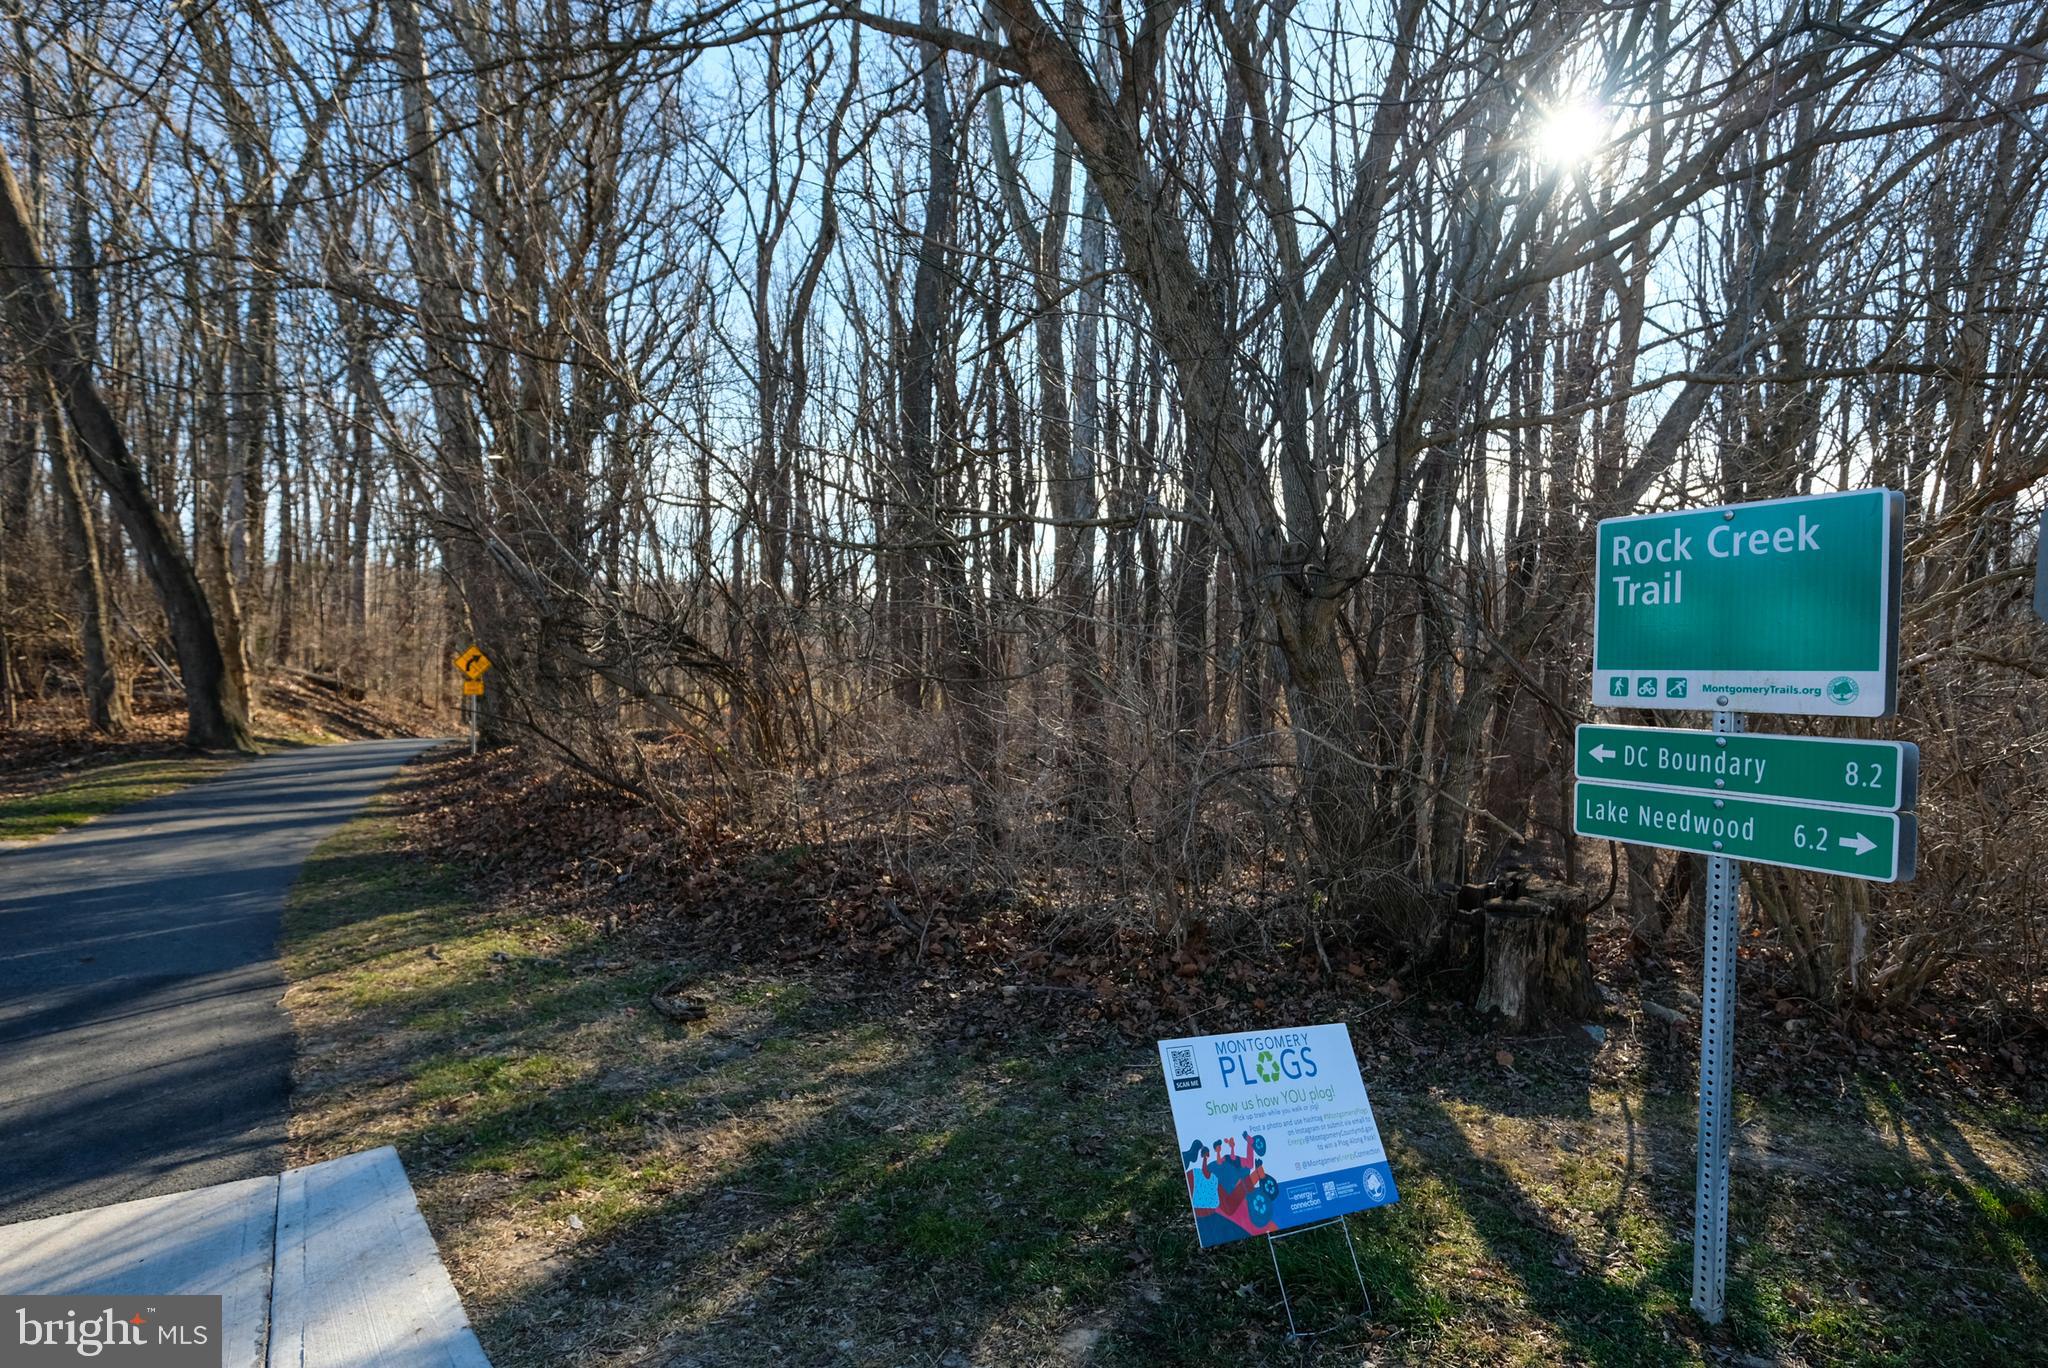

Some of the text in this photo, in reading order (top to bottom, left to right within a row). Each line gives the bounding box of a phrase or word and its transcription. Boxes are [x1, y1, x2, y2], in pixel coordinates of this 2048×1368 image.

[1612, 514, 1821, 566] Rock Creek
[1612, 570, 1683, 606] Trail
[1702, 684, 1822, 698] MontgomeryTrails.org
[1624, 745, 1883, 789] DC Boundary 8.2
[1586, 799, 1828, 851] Lake Needwood 6.2
[1215, 1033, 1308, 1055] MONTGOMERY
[1176, 1081, 1190, 1089] SCAN
[1205, 1084, 1335, 1116] Show us how YOU plog!
[1290, 1199, 1321, 1210] connection
[1294, 1191, 1312, 1200] energy
